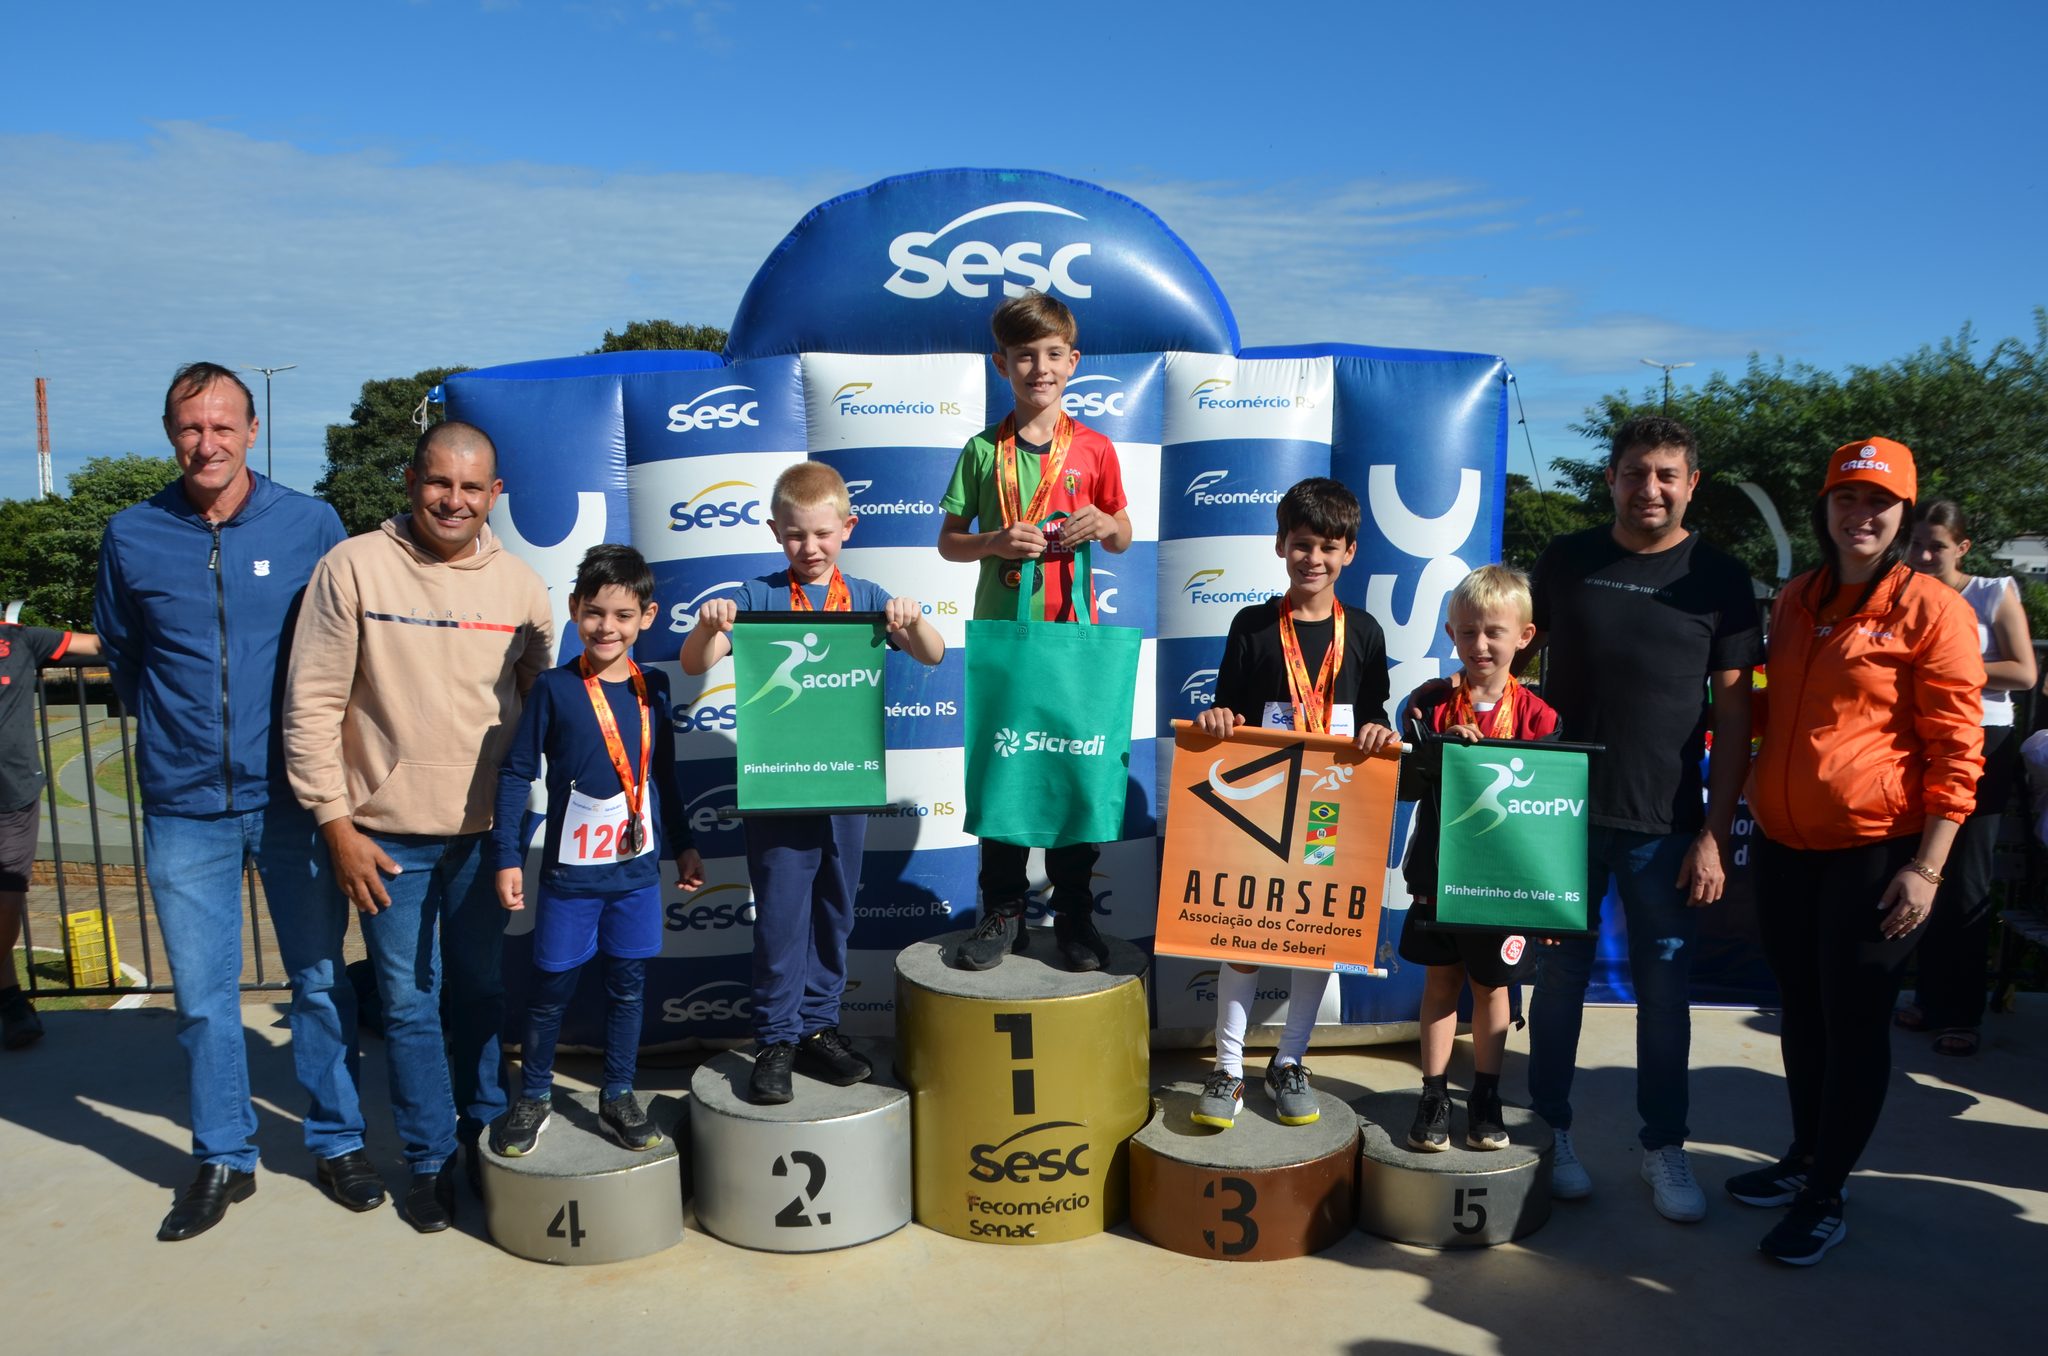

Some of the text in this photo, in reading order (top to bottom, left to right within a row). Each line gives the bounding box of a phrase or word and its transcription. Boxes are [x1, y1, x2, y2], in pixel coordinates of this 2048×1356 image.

[840, 401, 961, 416] Fecomércio RS
[1062, 392, 1124, 417] esc
[1198, 396, 1290, 409] Fecomércio
[1841, 460, 1892, 473] CRESOL
[850, 500, 934, 516] ecomércio
[937, 602, 958, 615] RS
[801, 669, 882, 689] acorPV
[935, 701, 957, 716] RS
[1023, 731, 1106, 757] Sicredi
[744, 762, 811, 774] Pinheirinho
[812, 761, 828, 772] do
[829, 761, 855, 771] Vale
[864, 760, 879, 771] RS
[933, 802, 955, 816] RS
[1507, 798, 1585, 817] acorPV
[1183, 869, 1367, 920] ACORSEB
[1445, 884, 1511, 898] Pinheirinho
[1513, 888, 1528, 899] do
[1531, 890, 1556, 900] Vale
[1564, 891, 1580, 902] RS
[854, 900, 952, 917] comércio RS
[1178, 908, 1362, 938] Associação dos Corredores
[1210, 933, 1327, 955] de Rua de Seberi
[993, 1012, 1036, 1115] 1
[772, 1150, 832, 1228] 2
[967, 1193, 1090, 1216] Fecomércio
[1452, 1187, 1488, 1236] 5
[547, 1200, 586, 1248] 4
[1202, 1177, 1259, 1256] 3
[969, 1219, 1036, 1239] Senac
